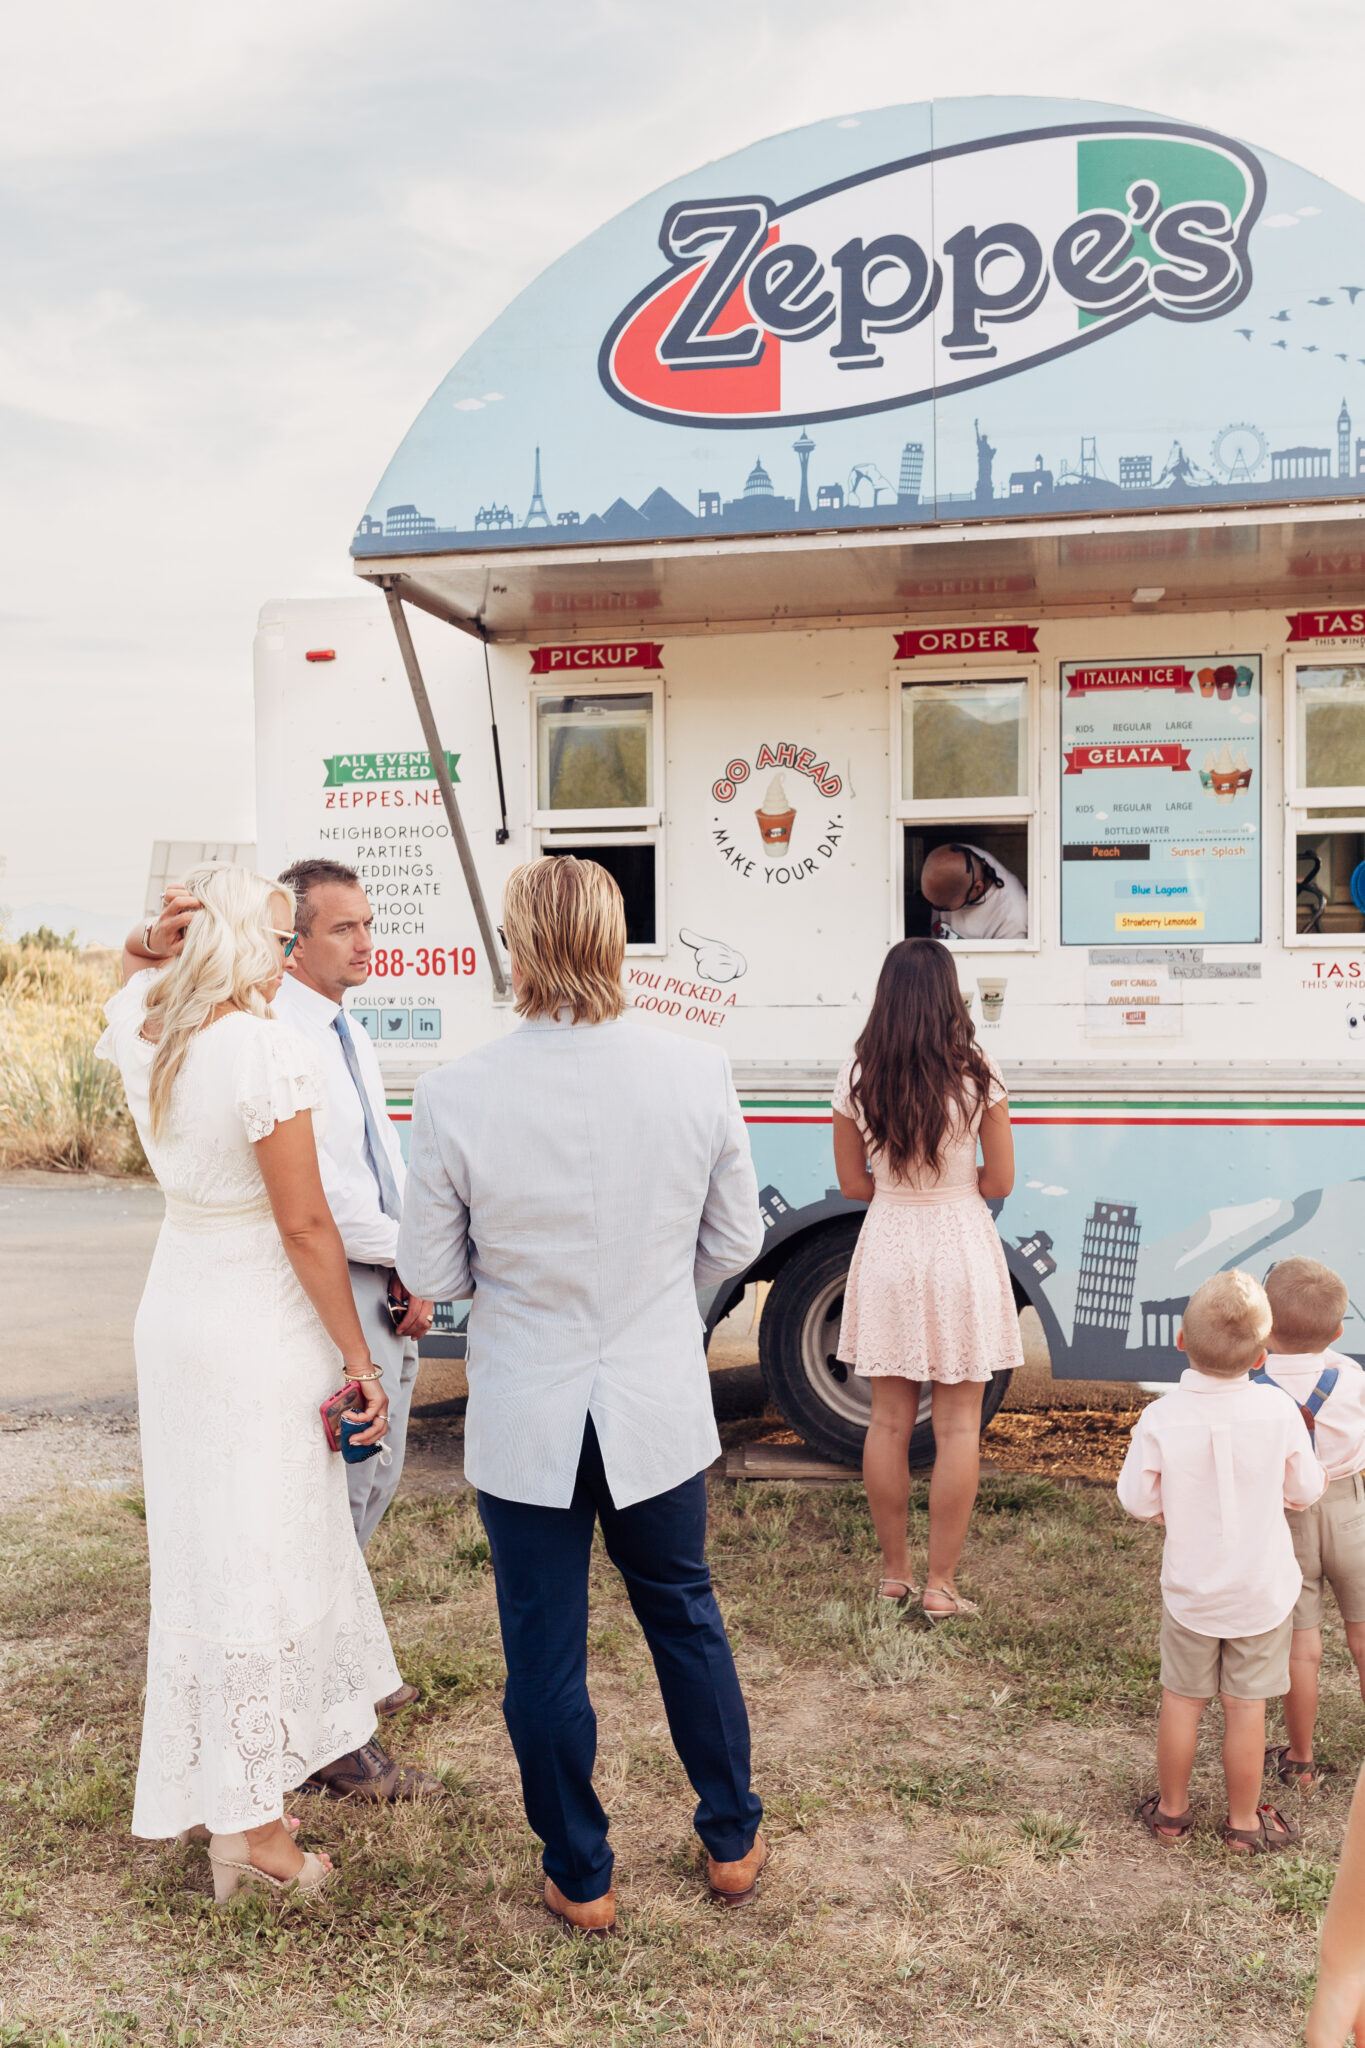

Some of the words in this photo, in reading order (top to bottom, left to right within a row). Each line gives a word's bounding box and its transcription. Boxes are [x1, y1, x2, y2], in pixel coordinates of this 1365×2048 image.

[661, 179, 1252, 372] Zeppe's
[918, 630, 1010, 650] ORDER
[1315, 638, 1336, 646] THIS
[550, 646, 639, 667] PICKUP
[1083, 669, 1143, 686] ITALIAN
[1149, 668, 1175, 683] ICE
[1075, 724, 1095, 733] KIDS
[1112, 722, 1152, 732] REGULAR
[1165, 721, 1193, 730] LARGE
[339, 755, 368, 768] ALL
[375, 751, 431, 766] EVENT
[1088, 747, 1165, 764] GELATA
[351, 766, 431, 780] CATERED
[712, 758, 751, 803] GO
[756, 742, 843, 798] AHEAD
[325, 788, 456, 809] ZEPPES.NE
[1075, 805, 1095, 814] KIDS
[1113, 803, 1152, 812] REGULAR
[1165, 802, 1193, 811] LARGE
[319, 824, 454, 840] NEIGHBORHOO
[1104, 826, 1141, 836] BOTTLED
[1142, 826, 1170, 835] WATER
[357, 844, 423, 858] PARTIES
[712, 829, 756, 878] MAKE
[764, 857, 820, 884] YOUR
[816, 819, 844, 858] DAY
[1092, 846, 1121, 858] Peach
[1171, 846, 1206, 857] Sunset
[1211, 845, 1246, 859] Splash
[365, 882, 441, 896] RPORATE
[1131, 884, 1151, 895] Blue
[1155, 884, 1188, 897] Lagoon
[369, 921, 425, 935] HURCH
[1122, 917, 1161, 928] Strawberry
[1163, 916, 1198, 927] Lemonade
[1312, 961, 1365, 979] TAS
[628, 968, 662, 989] YOU
[663, 977, 722, 1003] PICKED
[723, 992, 737, 1006] A
[1301, 980, 1328, 989] THIS
[353, 996, 396, 1006] FOLLOW
[400, 996, 414, 1006] US
[417, 996, 435, 1006] ON
[634, 993, 682, 1017] GOOD
[685, 1005, 726, 1028] ONE!
[372, 1041, 392, 1049] RUCK
